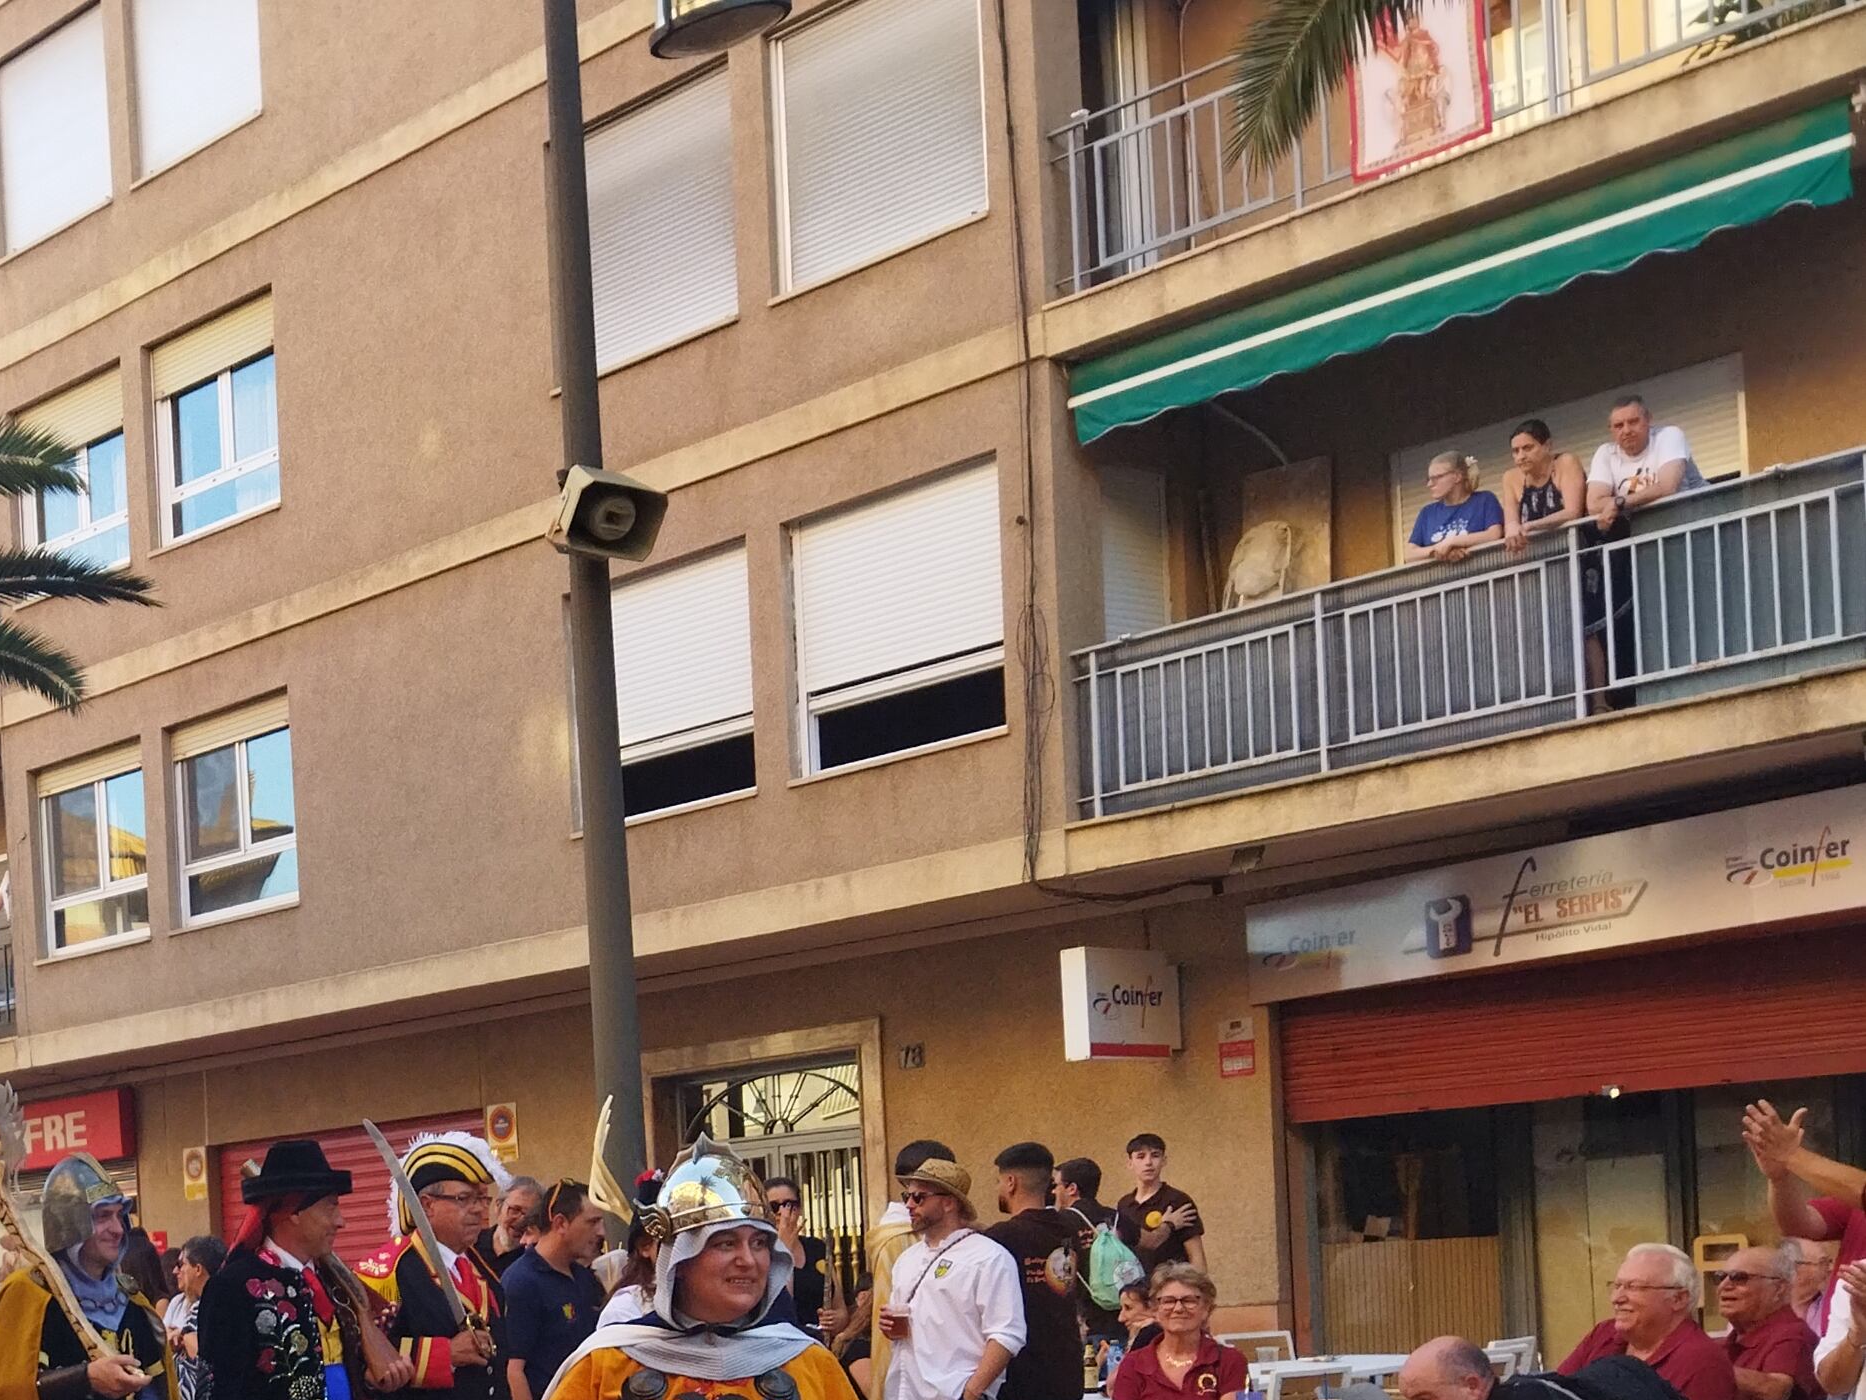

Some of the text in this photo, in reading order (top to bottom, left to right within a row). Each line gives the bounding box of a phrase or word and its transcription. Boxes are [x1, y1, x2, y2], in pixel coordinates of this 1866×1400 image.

[1759, 825, 1850, 888] Coinfer
[1583, 922, 1613, 935] Vidal
[1112, 975, 1163, 1029] Coinfer
